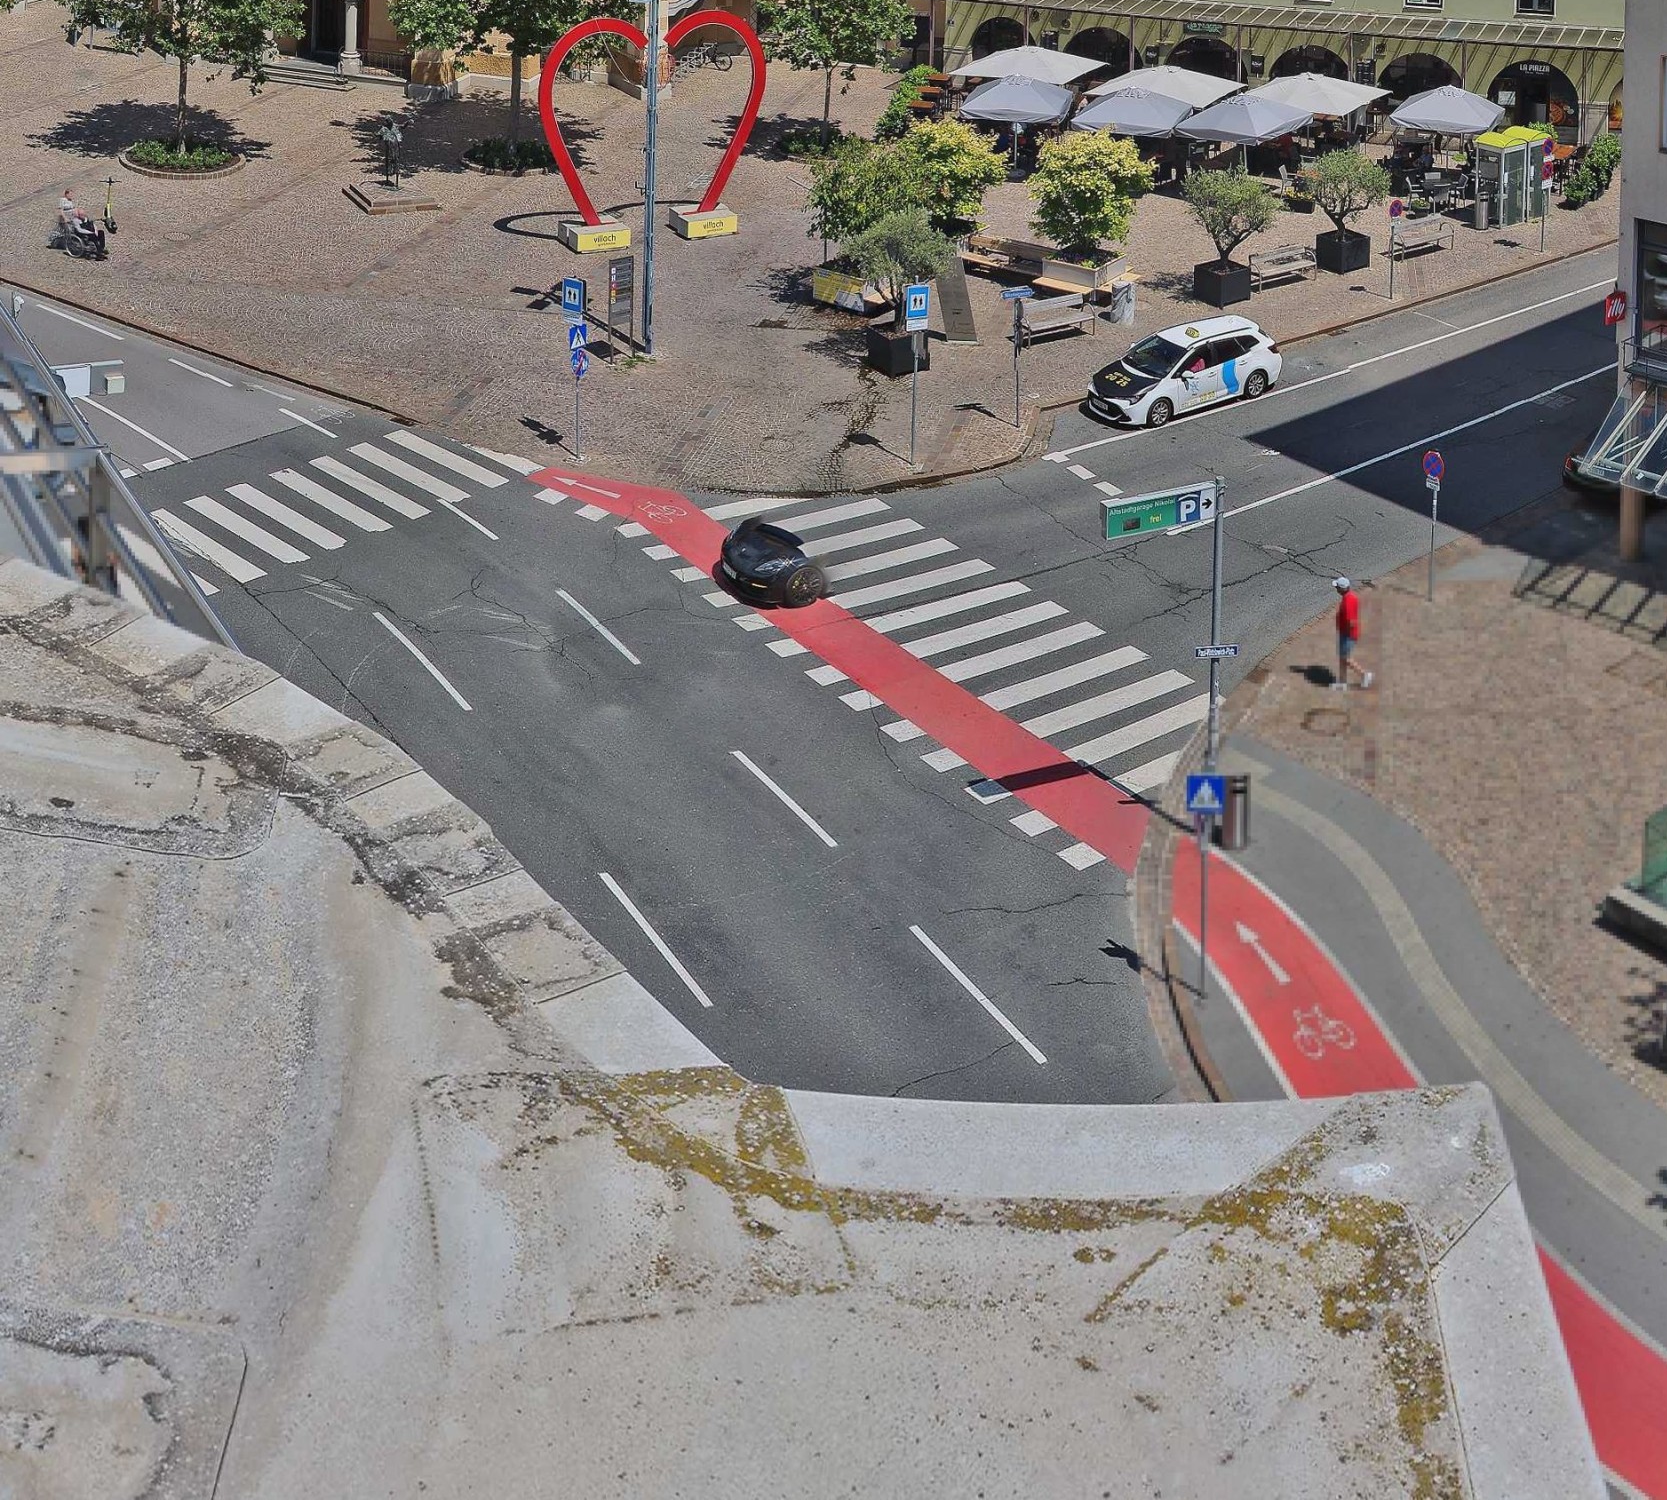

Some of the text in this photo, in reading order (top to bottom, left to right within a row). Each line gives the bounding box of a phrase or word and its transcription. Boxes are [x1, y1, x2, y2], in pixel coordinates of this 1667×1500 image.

[702, 220, 724, 230] villach
[593, 234, 617, 244] villach
[1607, 297, 1625, 320] illy
[1109, 502, 1154, 516] Altstadtgarage
[1149, 513, 1162, 524] frei
